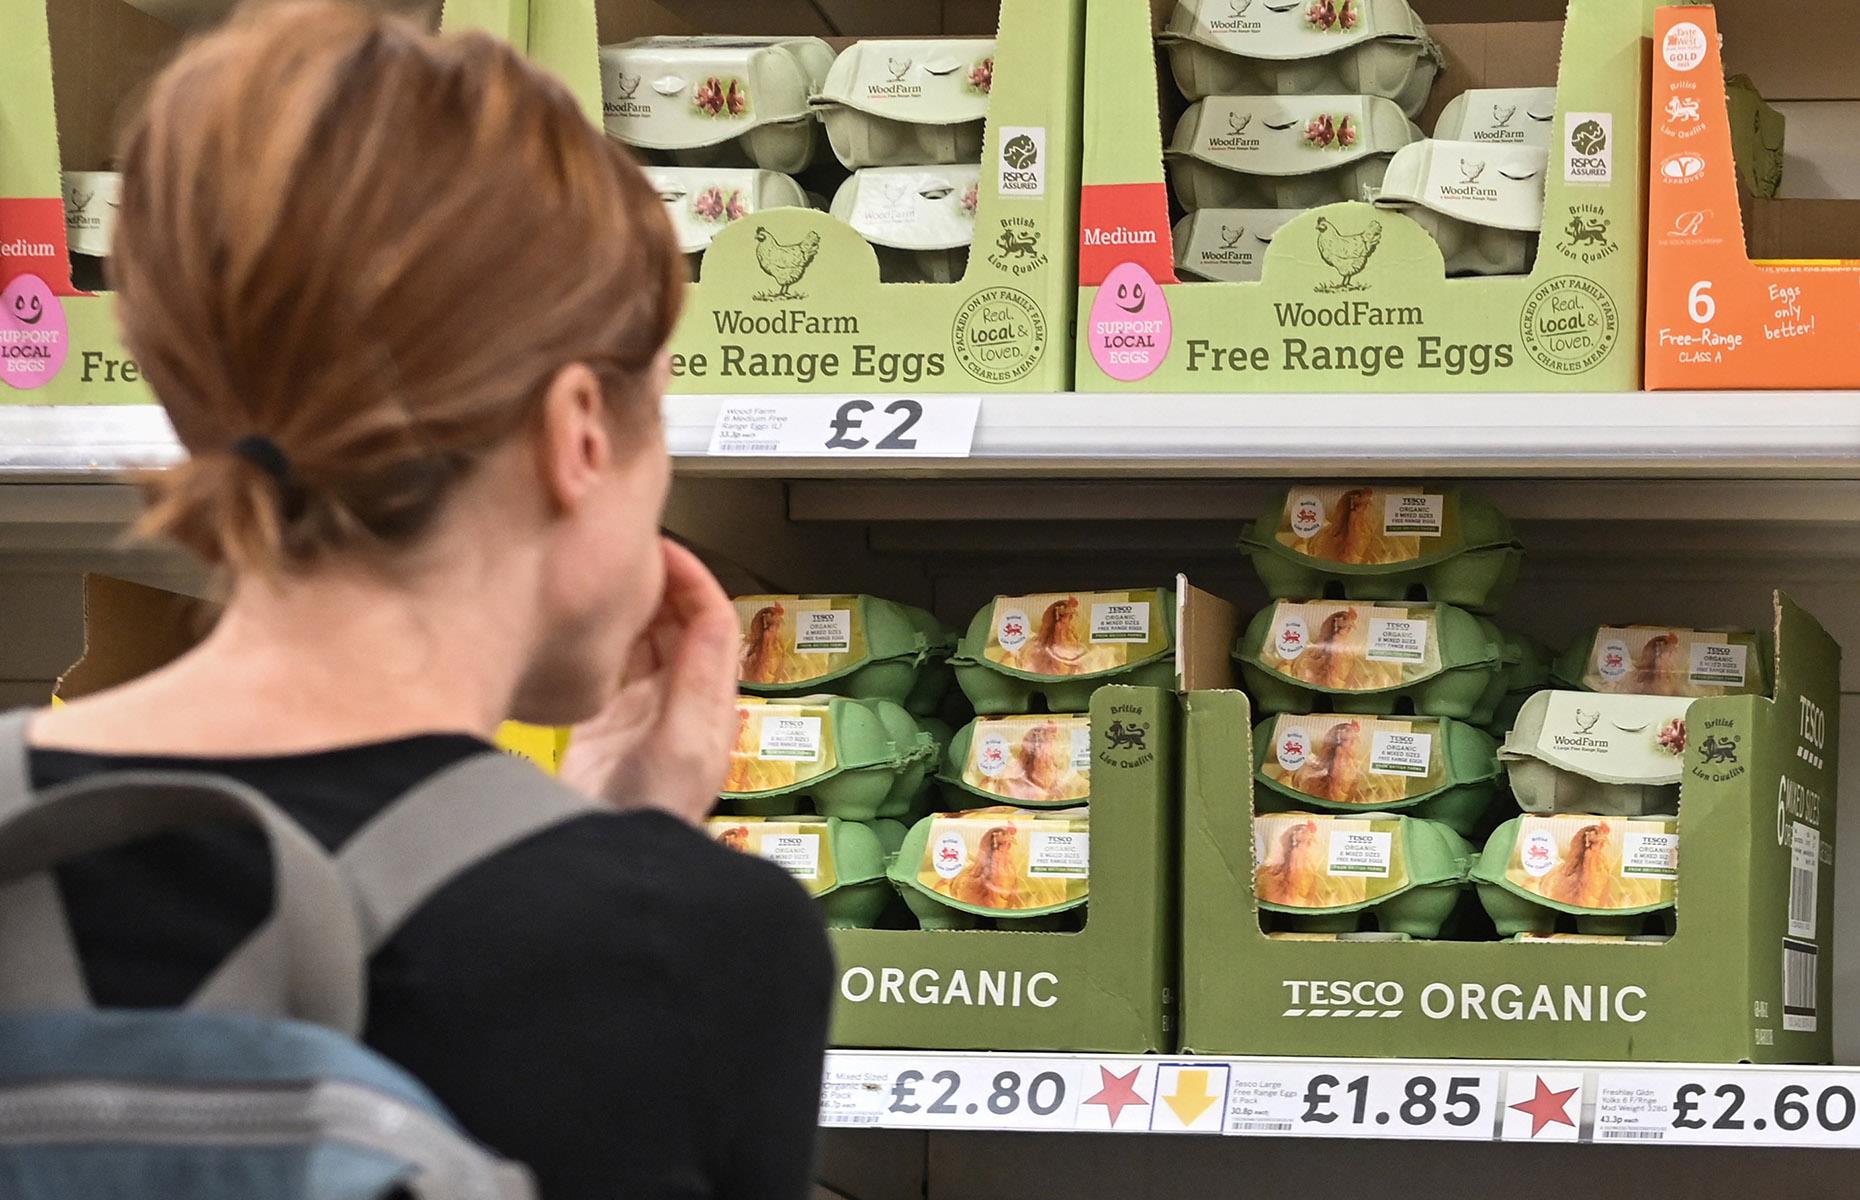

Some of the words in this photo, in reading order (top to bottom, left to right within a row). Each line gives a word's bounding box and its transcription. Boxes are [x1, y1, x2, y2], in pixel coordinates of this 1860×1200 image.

[1210, 20, 1262, 29] WoodFarm
[1670, 53, 1697, 62] GOLD
[867, 84, 922, 94] WoodFarm
[1670, 80, 1697, 92] British
[1474, 130, 1524, 140] WoodFarm
[1660, 124, 1676, 138] Lion
[1678, 122, 1706, 138] Quality
[1209, 138, 1260, 146] WoodFarm
[1571, 158, 1606, 168] RSPCA
[1003, 172, 1037, 182] RSPCA
[1570, 168, 1606, 176] ASSURED
[1663, 172, 1704, 184] APPROVED
[1003, 182, 1038, 190] ASSURED
[1440, 186, 1498, 196] WoodFarm
[1569, 204, 1604, 216] British
[1000, 217, 1035, 228] British
[1084, 227, 1156, 246] Medium
[1201, 251, 1253, 260] WoodFarm
[1556, 242, 1577, 260] Lion
[1582, 242, 1619, 264] Quality
[988, 254, 1008, 272] Lion
[1012, 254, 1049, 276] Quality
[1768, 284, 1801, 304] Eggs
[1551, 295, 1584, 314] Real.
[1688, 280, 1716, 324] 6
[982, 308, 1014, 324] Real.
[1274, 301, 1424, 327] WoodFarm
[1524, 301, 1538, 342] PACKED
[1536, 287, 1549, 301] ON
[1550, 280, 1566, 291] MY
[1569, 280, 1605, 301] FAMILY
[1602, 301, 1615, 330] FARM
[1774, 299, 1801, 321] only
[712, 310, 860, 334] WoodFarm
[955, 312, 969, 352] PACKED
[968, 298, 980, 312] ON
[982, 292, 997, 302] MY
[1000, 292, 1034, 312] FAMILY
[1031, 312, 1043, 341] FARM
[1588, 313, 1599, 326] &
[1018, 324, 1028, 338] &
[1096, 320, 1163, 335] SUPPORT
[1764, 314, 1815, 340] better!
[1104, 336, 1155, 348] LOCAL
[1659, 328, 1744, 350] Free-Range
[2, 345, 51, 358] LOCAL
[1110, 351, 1150, 364] EGGS
[1186, 340, 1269, 371] Free
[1282, 338, 1404, 377] Range
[1417, 336, 1514, 376] Eggs
[1538, 352, 1582, 371] CHARLES
[1583, 344, 1608, 367] MEAR
[1678, 352, 1712, 363] CLASS
[1714, 352, 1722, 363] A
[8, 360, 45, 372] EGGS
[670, 352, 707, 377] ee
[720, 346, 840, 384] Range
[852, 344, 946, 384] Eggs
[968, 362, 1011, 380] CHARLES
[1012, 354, 1037, 377] MEAR
[722, 423, 748, 431] Range
[824, 399, 923, 450] £2
[1110, 704, 1143, 715] British
[1704, 718, 1735, 730] British
[1800, 695, 1825, 750] TESCO
[1386, 744, 1417, 752] ORGANIC
[1554, 736, 1608, 747] WoodFarm
[1099, 752, 1118, 766] Lion
[1120, 752, 1154, 768] Quality
[1692, 766, 1710, 782] Lion
[1712, 766, 1745, 782] Quality
[1776, 774, 1787, 846] 6
[840, 966, 1059, 1008] ORGANIC
[1281, 980, 1405, 1007] TESCO
[1420, 982, 1648, 1023] ORGANIC
[836, 1072, 862, 1080] Mixed
[863, 1072, 888, 1081] Sized
[1235, 1080, 1258, 1088] Tesco
[1259, 1080, 1282, 1090] Large
[830, 1090, 850, 1099] Pack
[888, 1069, 1066, 1115] £2.80
[1233, 1088, 1252, 1096] Free
[1254, 1088, 1278, 1098] Range
[1280, 1089, 1298, 1098] Eggs
[1602, 1088, 1634, 1096] Freshlay
[1240, 1096, 1258, 1104] Pack
[1301, 1074, 1481, 1126] £1.85
[1671, 1082, 1857, 1131] £2.60
[1618, 1105, 1645, 1113] Weight
[1600, 1116, 1623, 1124] 43.3p
